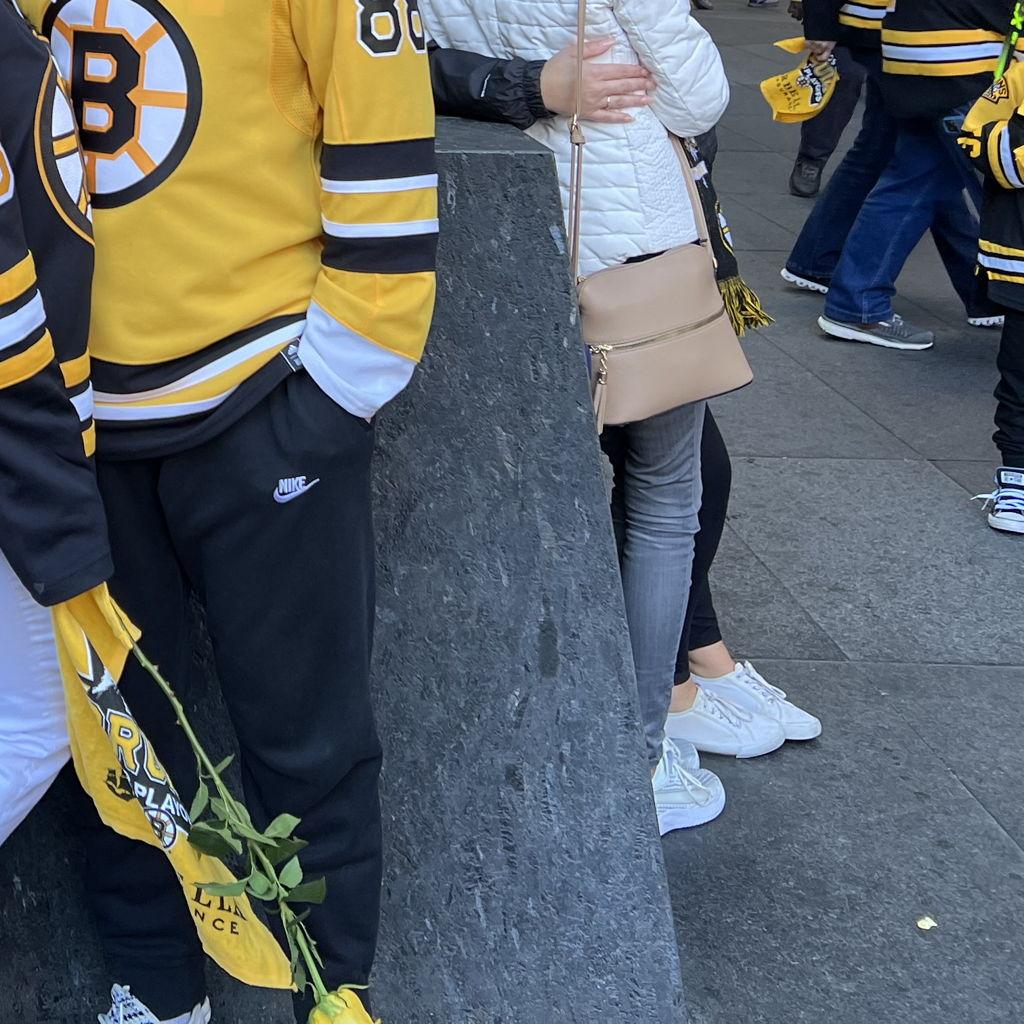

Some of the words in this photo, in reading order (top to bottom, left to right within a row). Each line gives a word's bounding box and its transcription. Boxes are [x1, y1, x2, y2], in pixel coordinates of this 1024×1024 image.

[69, 29, 141, 156] B
[278, 476, 307, 494] NIKE
[133, 781, 191, 825] PLAYO
